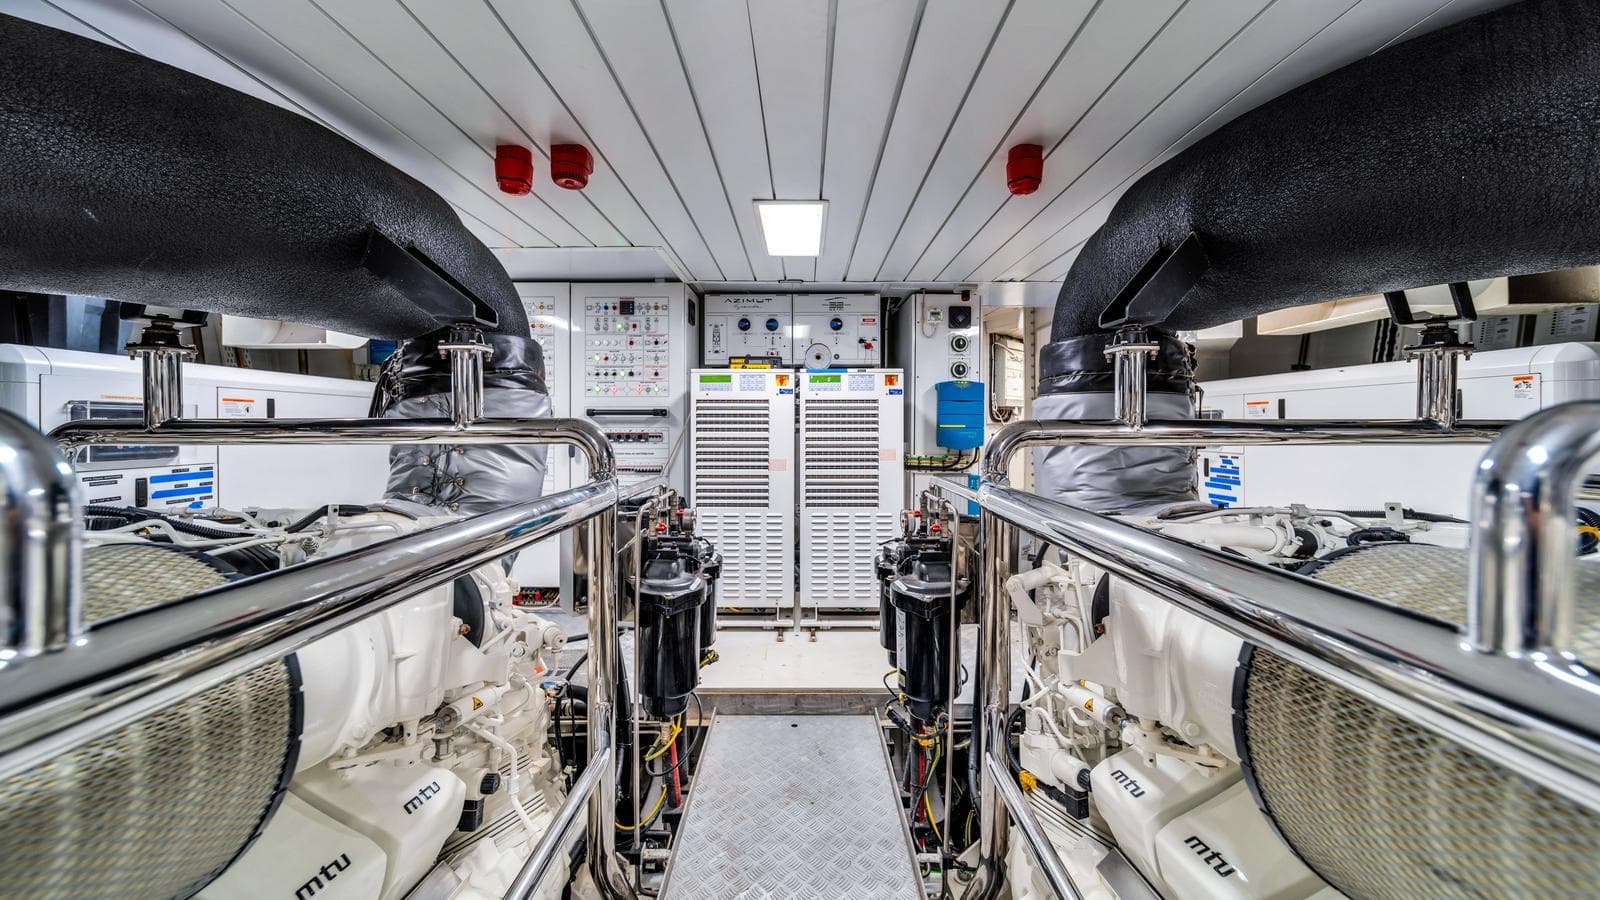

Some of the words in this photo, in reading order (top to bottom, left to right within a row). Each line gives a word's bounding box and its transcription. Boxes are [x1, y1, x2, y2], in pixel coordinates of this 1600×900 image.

[403, 781, 441, 815] mtu
[1110, 769, 1146, 798] mtu
[1184, 835, 1236, 878] mtu
[295, 852, 352, 900] mtu
